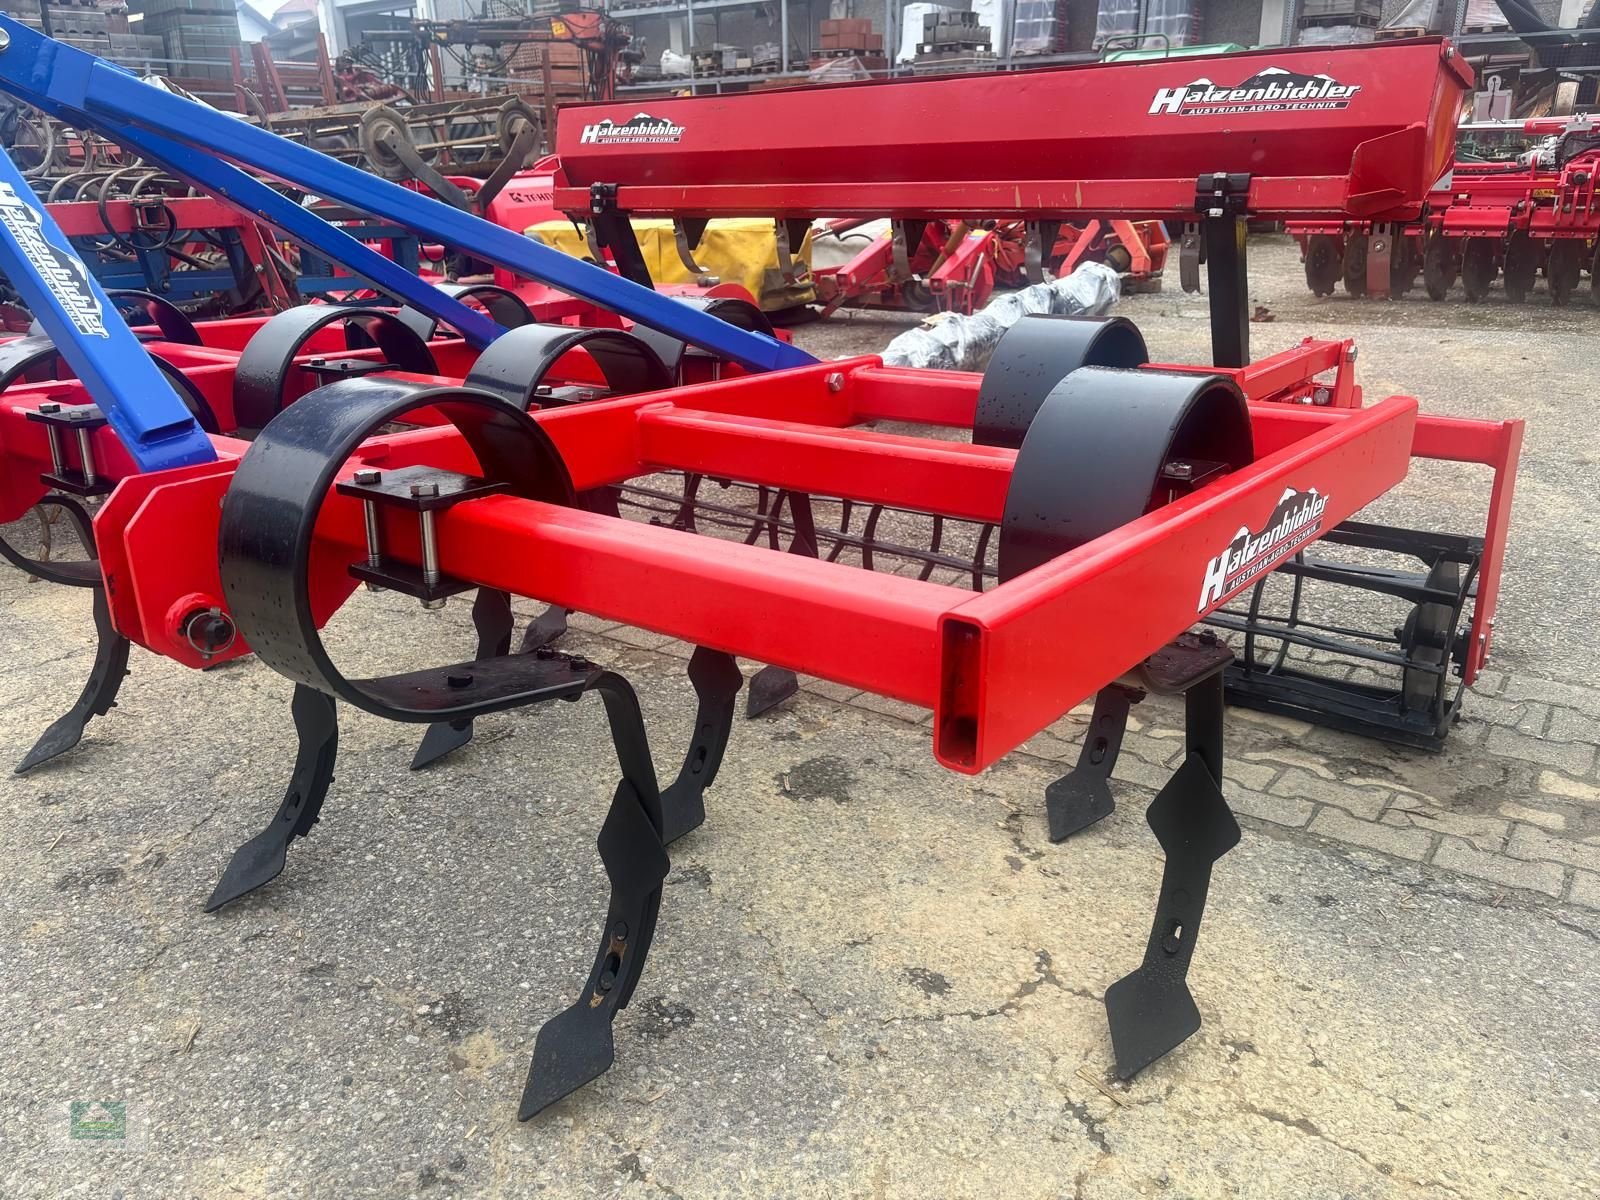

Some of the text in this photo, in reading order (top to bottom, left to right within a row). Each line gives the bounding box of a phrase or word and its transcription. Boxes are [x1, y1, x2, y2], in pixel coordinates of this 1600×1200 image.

[1148, 80, 1361, 114] Hatzenbichler
[1188, 101, 1338, 115] AUSTRIAN-AGRO-TECHNIK
[580, 122, 685, 144] Hatzenbichler
[0, 182, 109, 338] Hatzenbichler
[1198, 494, 1329, 613] Hatzenbichler
[1230, 524, 1317, 590] AUSTRIAN-AGRO-TECHNIK
